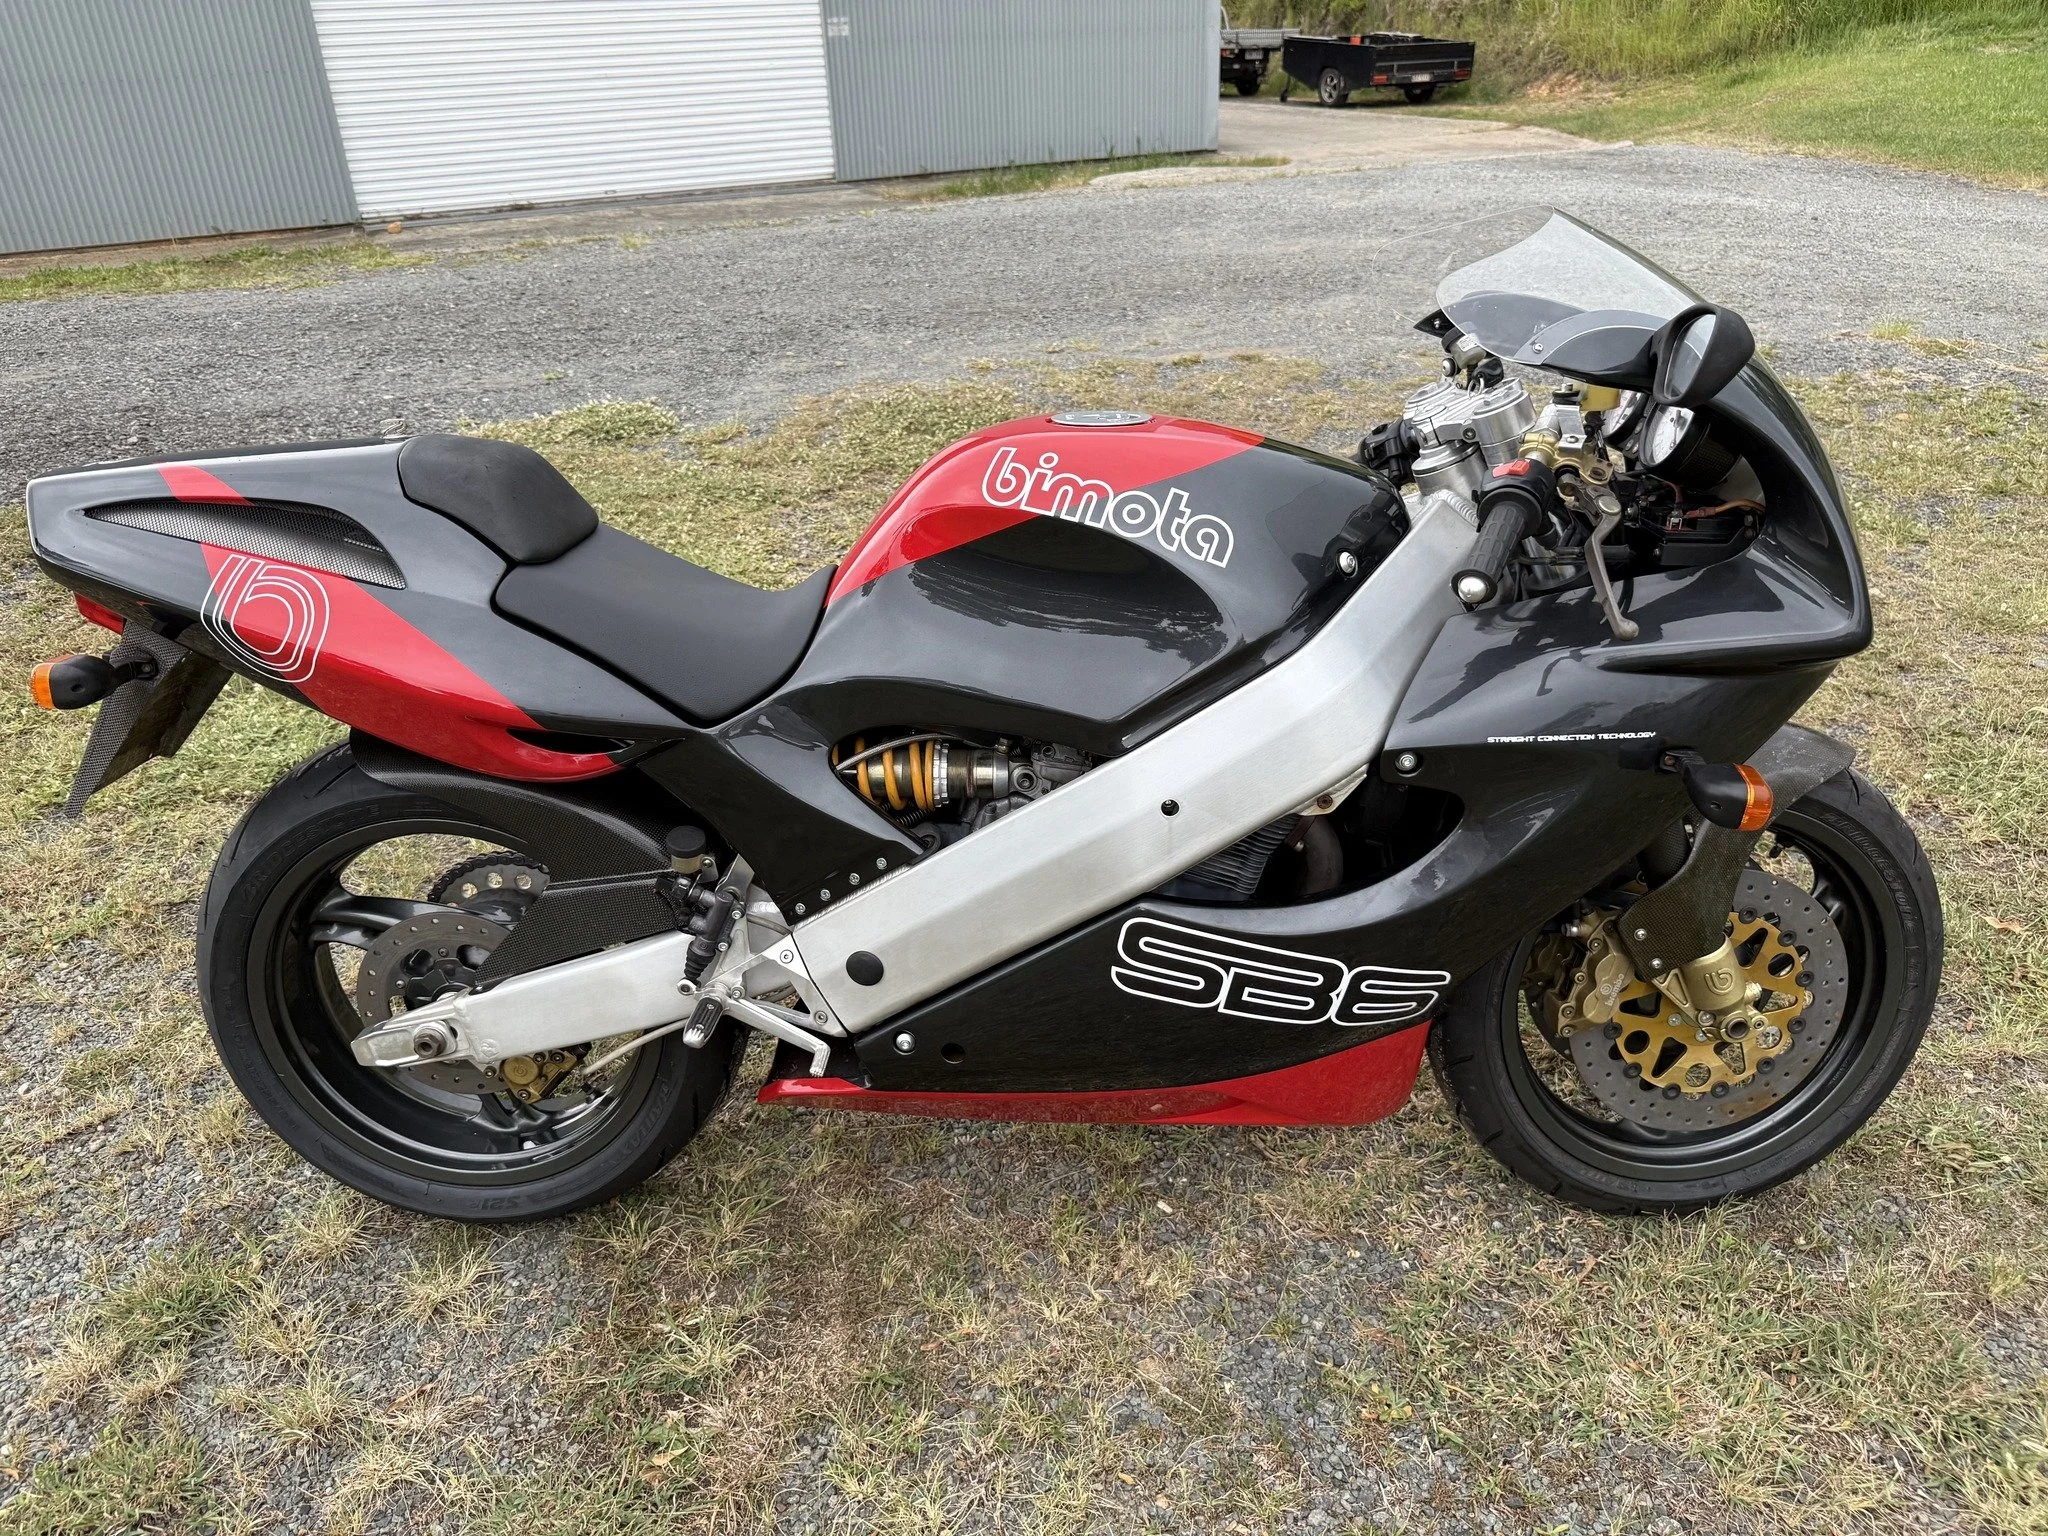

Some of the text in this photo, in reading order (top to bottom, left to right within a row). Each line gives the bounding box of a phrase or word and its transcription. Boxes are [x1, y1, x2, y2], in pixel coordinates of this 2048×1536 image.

[981, 446, 1235, 569] bimota
[1486, 731, 1656, 743] STRAIGHT CONNECTION TECHNOLOGY
[1110, 917, 1451, 1027] SB6
[1604, 973, 1625, 1006] brembo
